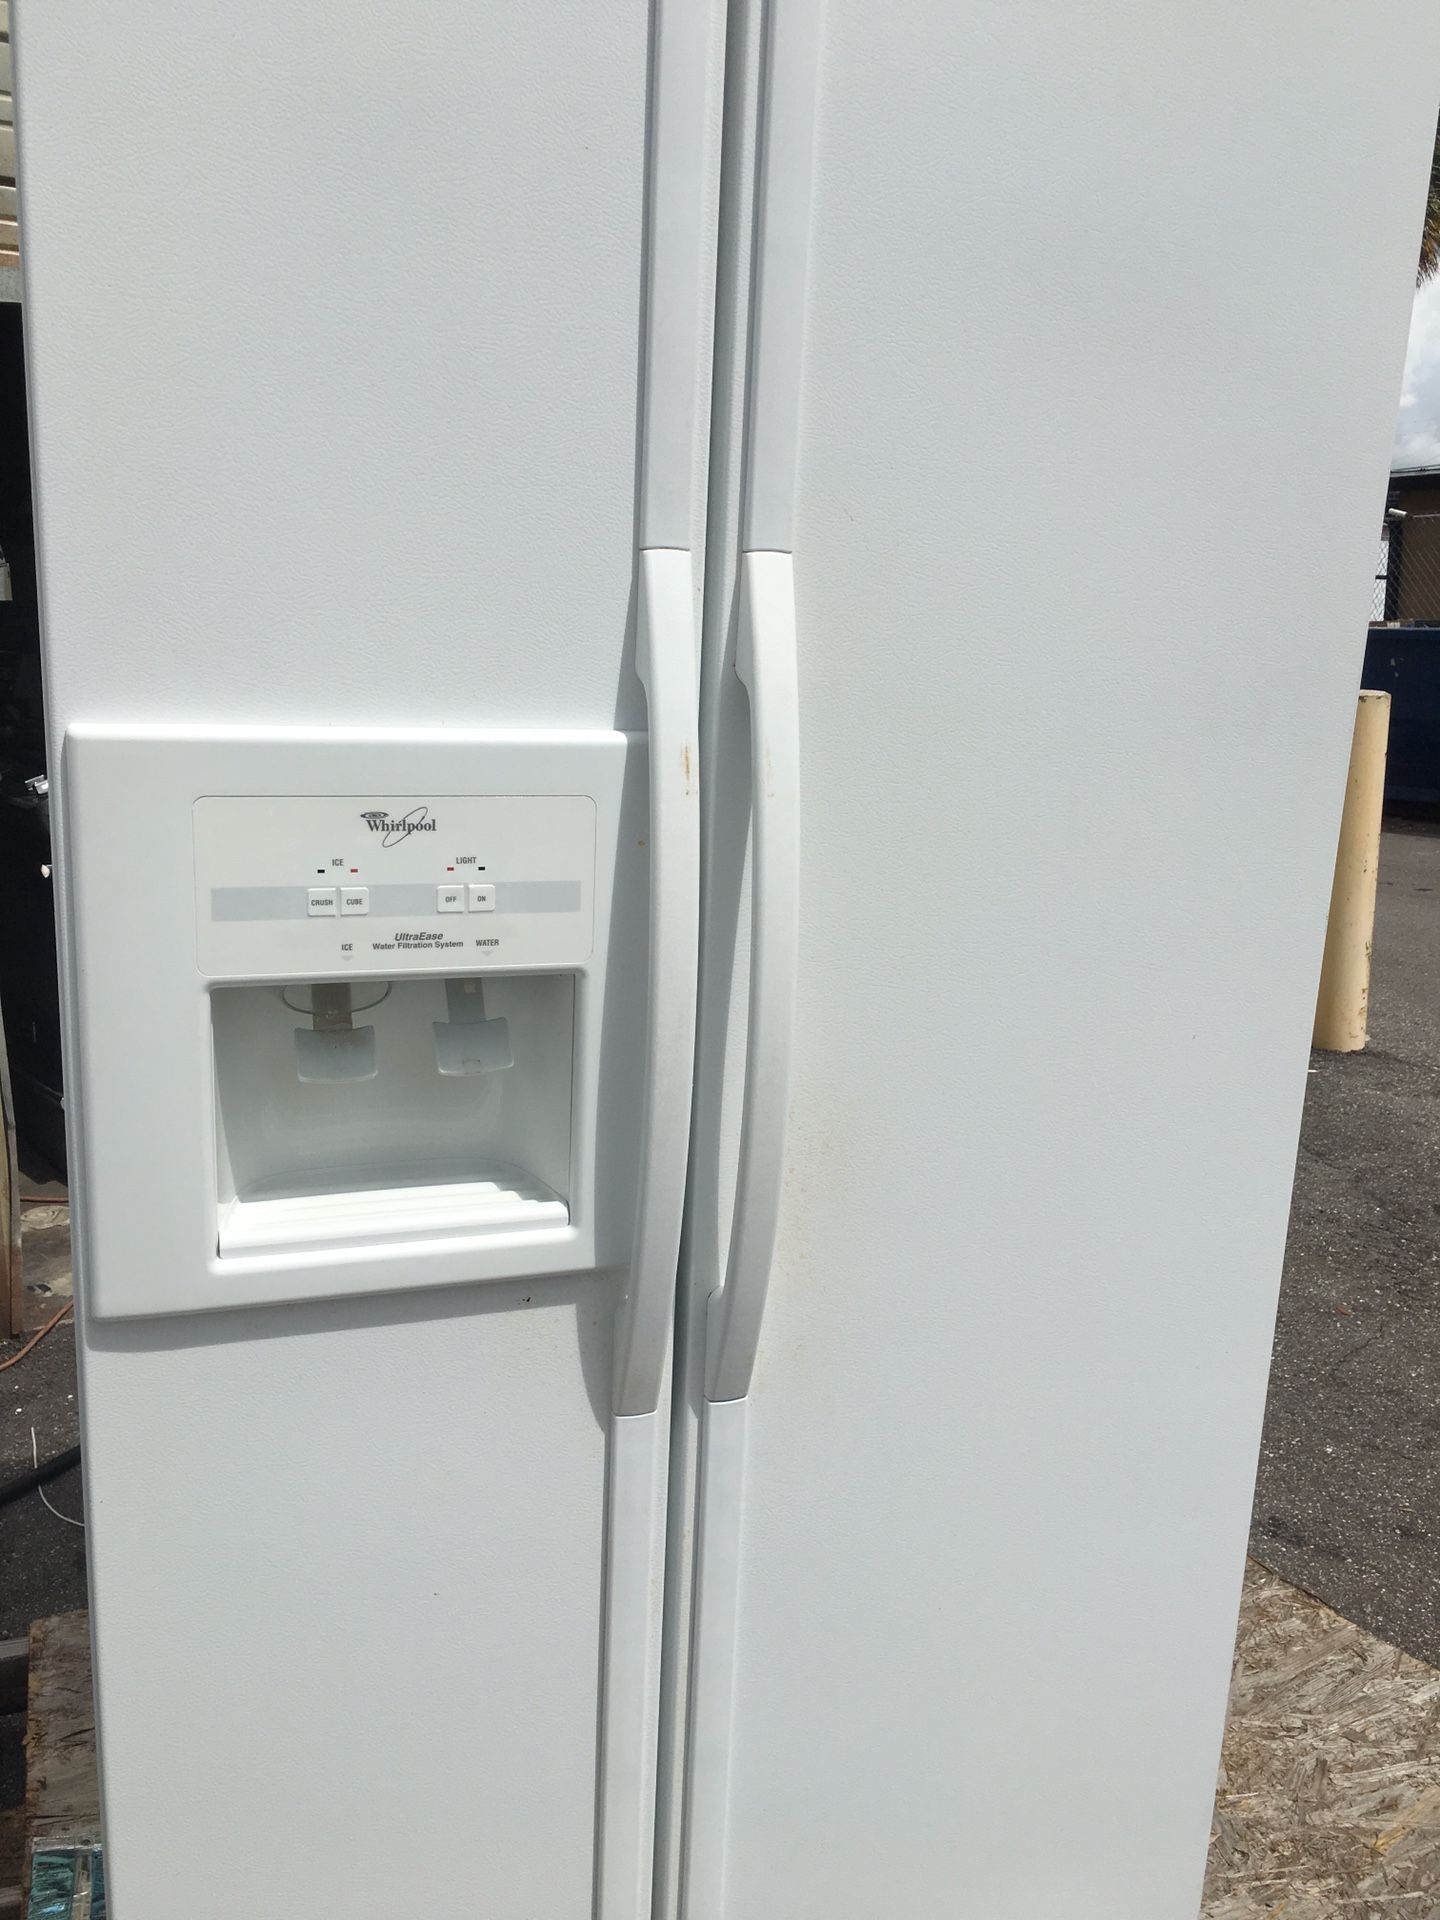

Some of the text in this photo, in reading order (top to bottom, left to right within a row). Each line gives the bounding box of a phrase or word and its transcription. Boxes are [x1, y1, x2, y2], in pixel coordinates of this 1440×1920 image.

[366, 819, 437, 834] Whirlpool
[395, 932, 443, 941] UltraEase
[373, 940, 463, 950] Water Filtration System
